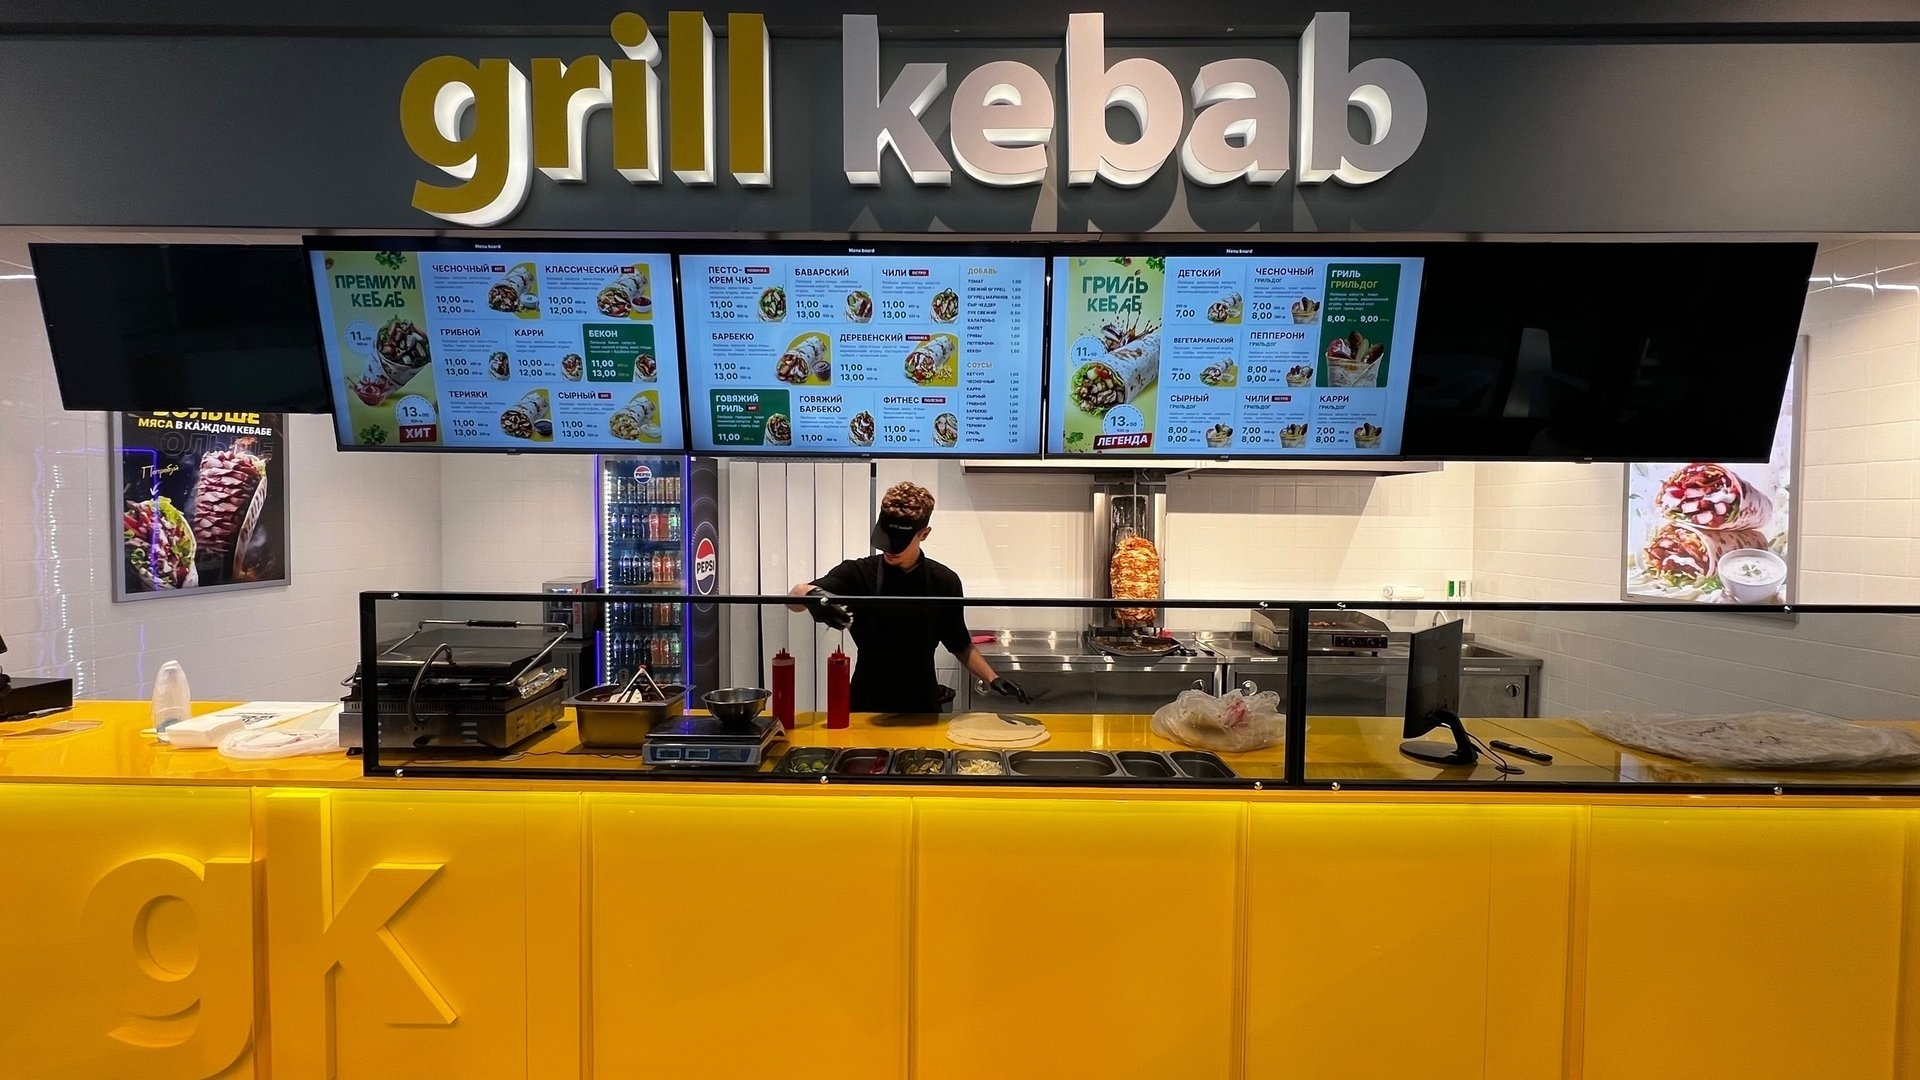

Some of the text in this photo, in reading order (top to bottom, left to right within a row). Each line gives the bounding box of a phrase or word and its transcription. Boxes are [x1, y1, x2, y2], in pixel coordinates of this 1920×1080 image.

[400, 10, 1430, 227] grill kebab
[432, 264, 490, 272] ЧЕСНОЧНЫЙ
[545, 265, 619, 273] КЛАССИЧЕСКИЙ
[795, 268, 849, 276] БАВАРСКИЙ
[1256, 267, 1314, 276] ЧЕСНОЧНЫЙ
[882, 269, 907, 277] ЧИЛИ
[1178, 268, 1221, 278] ДЕТСКИЙ
[1332, 270, 1361, 278] ГРИЛЬ
[335, 275, 416, 289] ПРЕМИУМ
[1082, 276, 1148, 293] ГРИЛЬ
[1331, 281, 1378, 289] ГРИЛЬДОГ
[351, 291, 405, 308] КЕБАБ
[436, 296, 461, 304] 10,00
[548, 297, 572, 305] 10,00
[710, 301, 732, 309] 11,00
[796, 301, 818, 309] 11,00
[882, 301, 905, 309] 11,00
[1087, 296, 1142, 312] КЕБАБ
[437, 306, 461, 314] 12,00
[550, 307, 573, 315] 12,00
[1175, 310, 1195, 318] 7,00
[711, 311, 735, 319] 13,00
[797, 311, 820, 319] 13,00
[882, 311, 906, 319] 13,00
[1252, 312, 1272, 320] 8,00
[440, 328, 481, 336] ГРИБНОЙ
[514, 329, 544, 337] КАРРИ
[588, 330, 618, 338] БЕКОН
[840, 333, 903, 342] ДЕРЕВЕНСКИЙ
[444, 358, 467, 366] 11,00
[518, 360, 542, 368] 10,00
[446, 368, 469, 376] 13,00
[841, 364, 862, 372] 11,00
[1247, 366, 1268, 374] 8,00
[592, 370, 616, 378] 13,00
[841, 374, 864, 382] 13,00
[1171, 373, 1191, 382] 7,00
[1247, 375, 1267, 383] 9,00
[558, 391, 596, 399] СЫРНЫЙ
[716, 394, 759, 402] ГОВЯЖИЙ
[799, 394, 842, 403] ГОВЯЖИЙ
[1170, 394, 1209, 402] СЫРНЫЙ
[800, 405, 842, 413] БАРБЕКЮ
[138, 418, 173, 428] МЯСА
[175, 421, 183, 429] В
[185, 422, 236, 433] КАЖДОМ
[237, 426, 272, 436] КЕБАБЕ
[453, 420, 474, 428] 11,00
[561, 421, 582, 429] 11,00
[405, 427, 431, 439] ХИТ
[454, 429, 477, 437] 13,00
[883, 426, 906, 434] 11,00
[1168, 427, 1188, 435] 8,00
[1242, 427, 1261, 435] 7,00
[718, 434, 740, 442] 11,00
[1096, 434, 1148, 447] ЛЕГЕНДА
[1241, 436, 1261, 444] 8,00
[1316, 436, 1336, 444] 8,00
[697, 560, 714, 574] PEPSI
